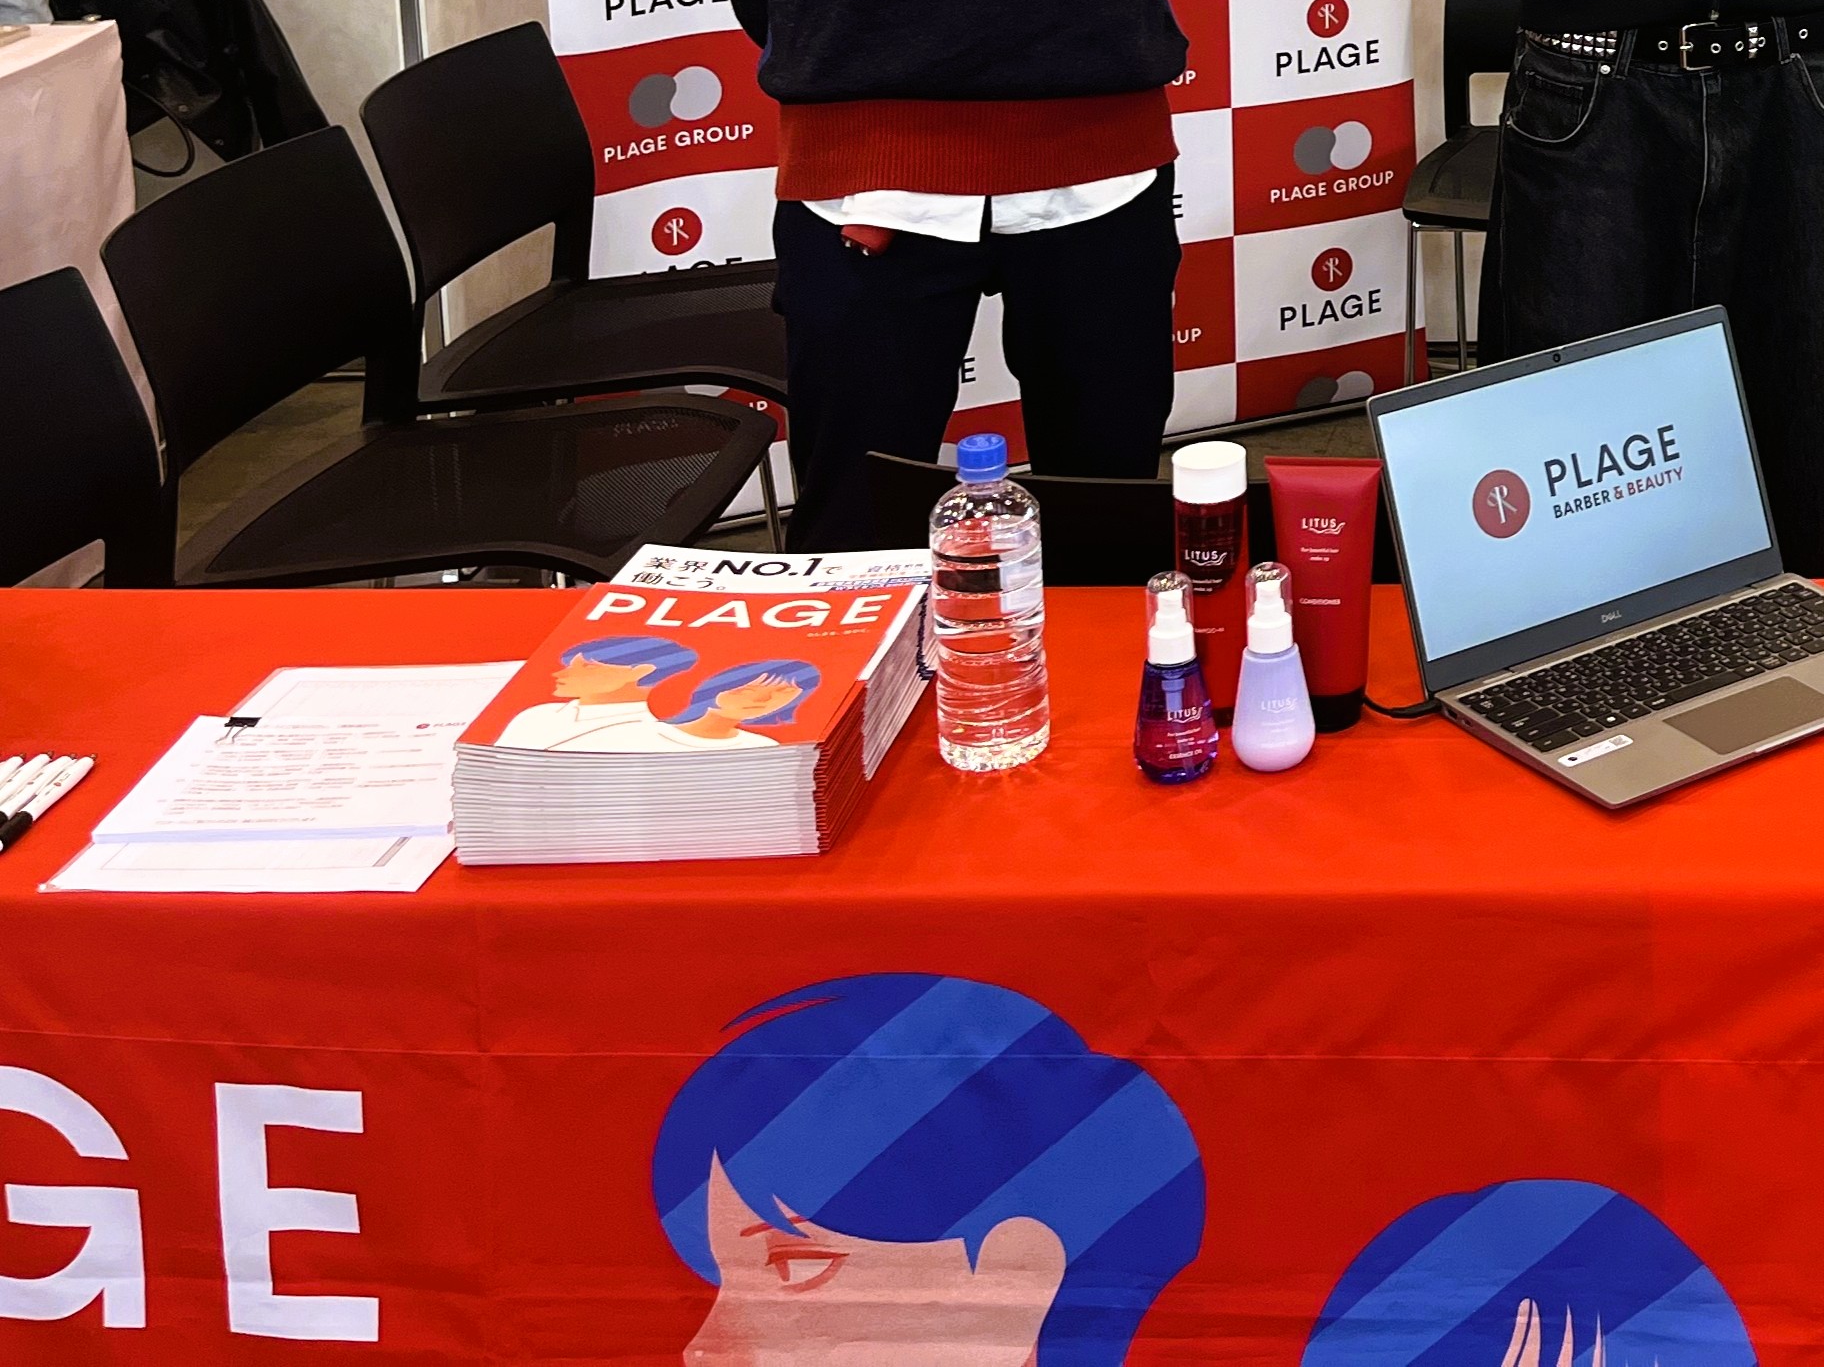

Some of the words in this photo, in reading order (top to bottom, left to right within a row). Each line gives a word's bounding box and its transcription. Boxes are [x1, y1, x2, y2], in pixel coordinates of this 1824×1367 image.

[1276, 40, 1380, 77] PLAGE
[604, 136, 667, 163] PLAGE
[674, 124, 754, 147] GROUP
[1270, 182, 1327, 203] PLAGE
[1333, 171, 1394, 193] GROUP
[1280, 289, 1382, 331] PLAGE
[1544, 424, 1680, 497] PLAGE
[1553, 490, 1611, 519] BARBER
[1613, 486, 1624, 500] &
[1627, 466, 1683, 496] BEAUTY
[586, 591, 892, 629] PLAGE
[1601, 610, 1622, 623] DELL
[1167, 707, 1197, 721] LITUS
